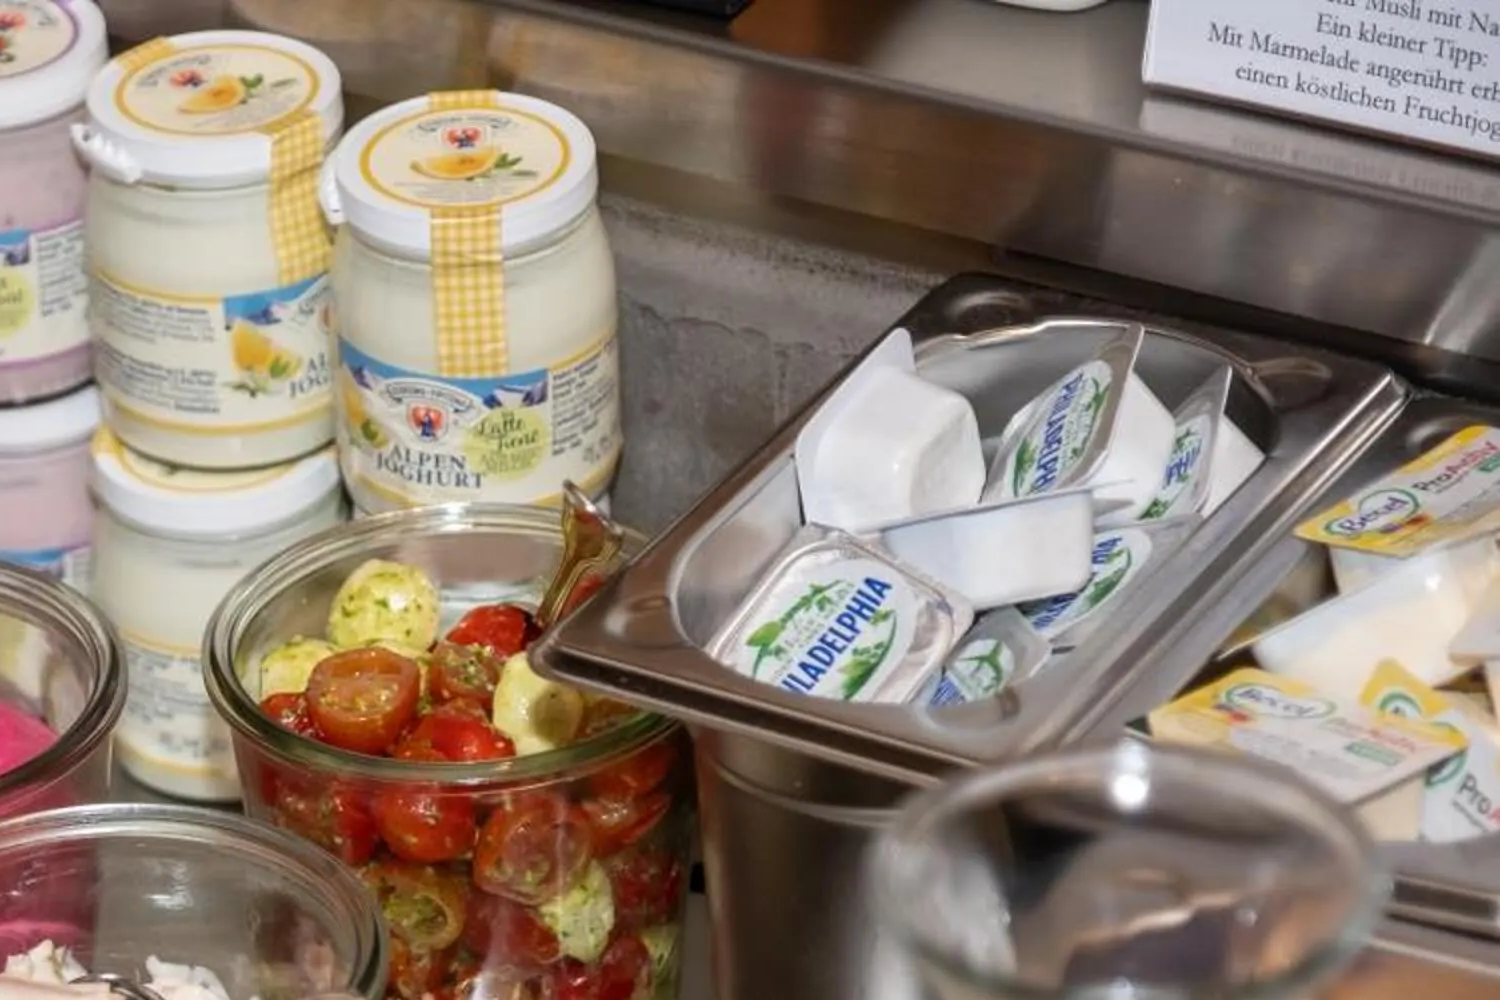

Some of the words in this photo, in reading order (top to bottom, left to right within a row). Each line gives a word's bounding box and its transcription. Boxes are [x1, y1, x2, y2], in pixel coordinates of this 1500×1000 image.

[1315, 12, 1352, 39] Ein
[1357, 21, 1428, 54] kleiner
[1433, 37, 1489, 71] Tipp:
[1426, 7, 1462, 30] mit
[1207, 21, 1244, 48] Mit
[1249, 30, 1360, 73] Marmelade
[1365, 62, 1466, 95] angerührt
[1235, 62, 1289, 89] einen
[1294, 71, 1396, 113] köstlichen
[376, 453, 483, 489] JOGHURT
[389, 443, 467, 469] ALPEN
[781, 577, 893, 693] ILADELPHIA
